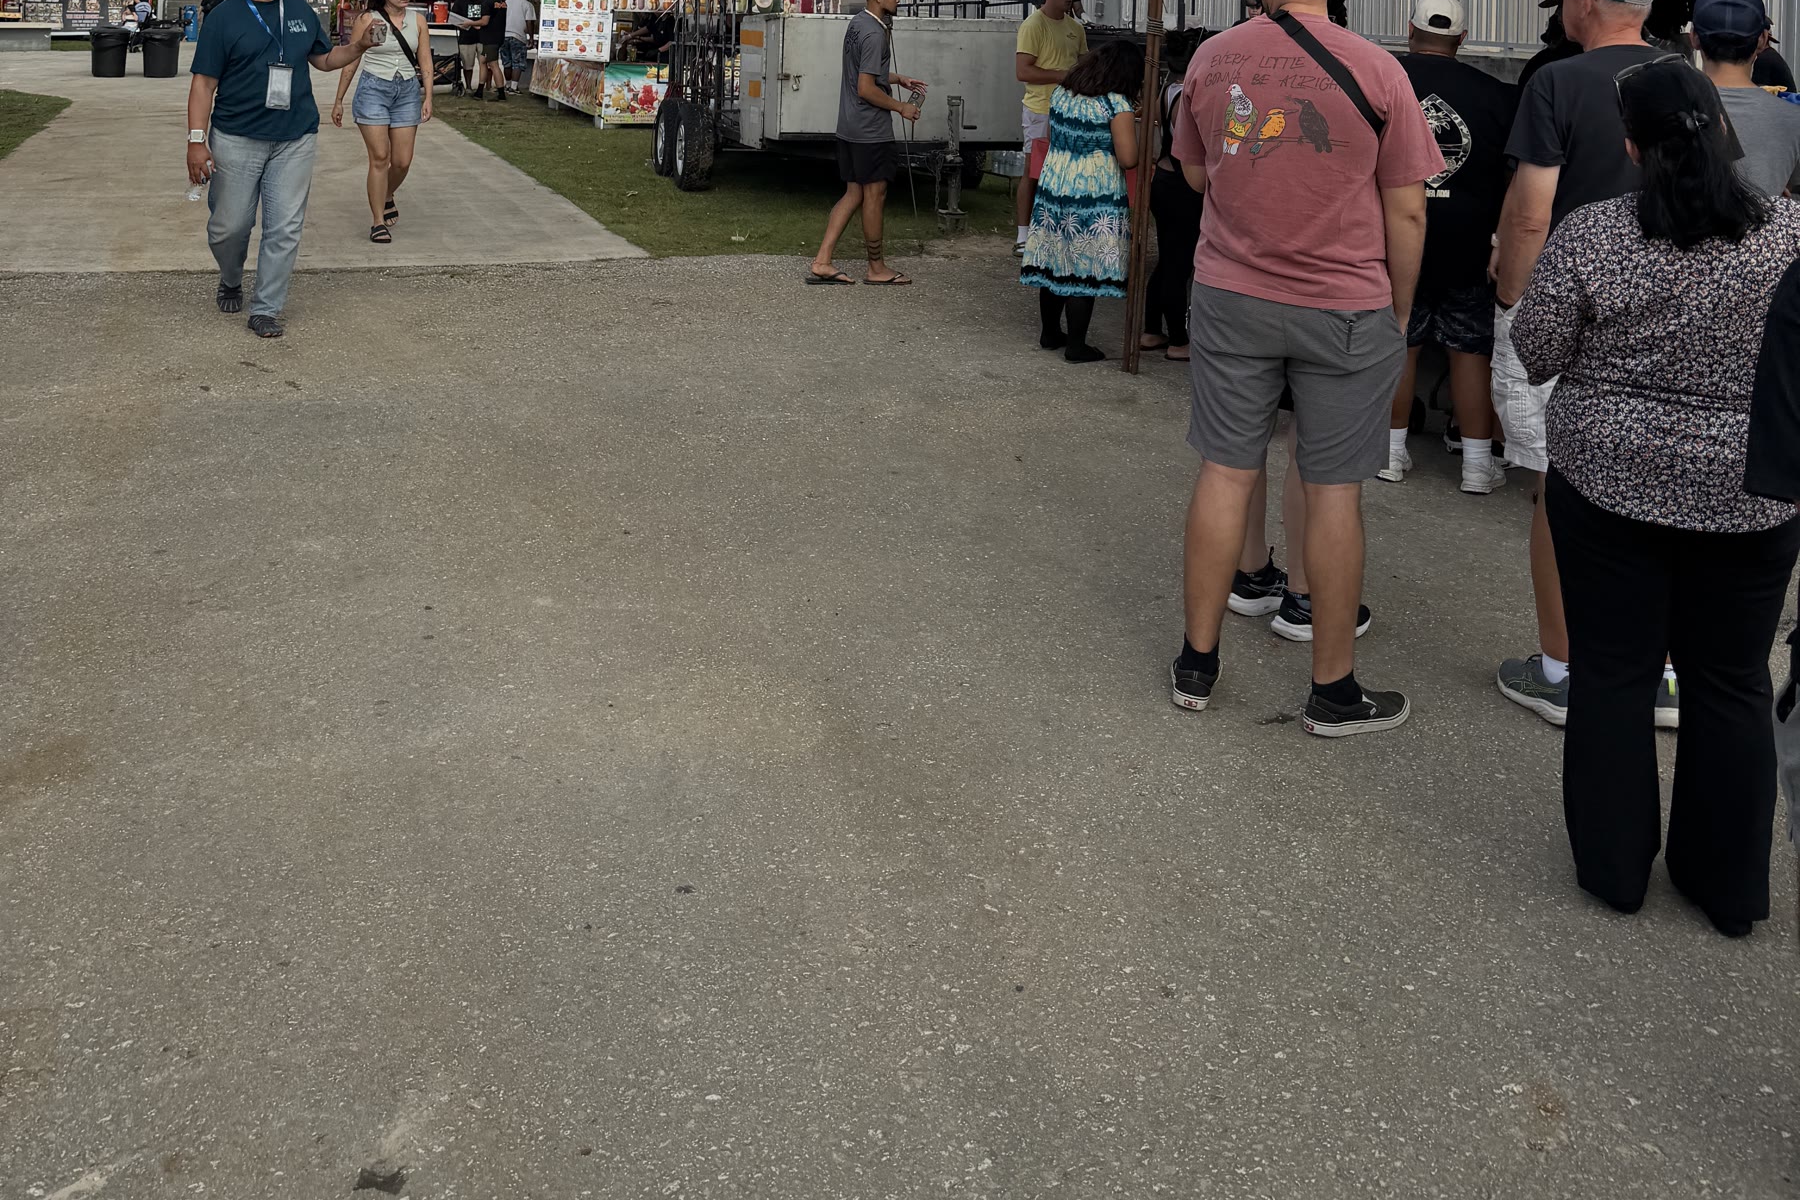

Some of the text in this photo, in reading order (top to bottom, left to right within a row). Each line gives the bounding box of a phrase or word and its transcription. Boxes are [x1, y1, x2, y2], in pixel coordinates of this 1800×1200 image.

[1210, 53, 1252, 71] EVERY
[1258, 56, 1305, 70] LITTLE
[1204, 71, 1342, 92] GONNA BE ALRIGH
